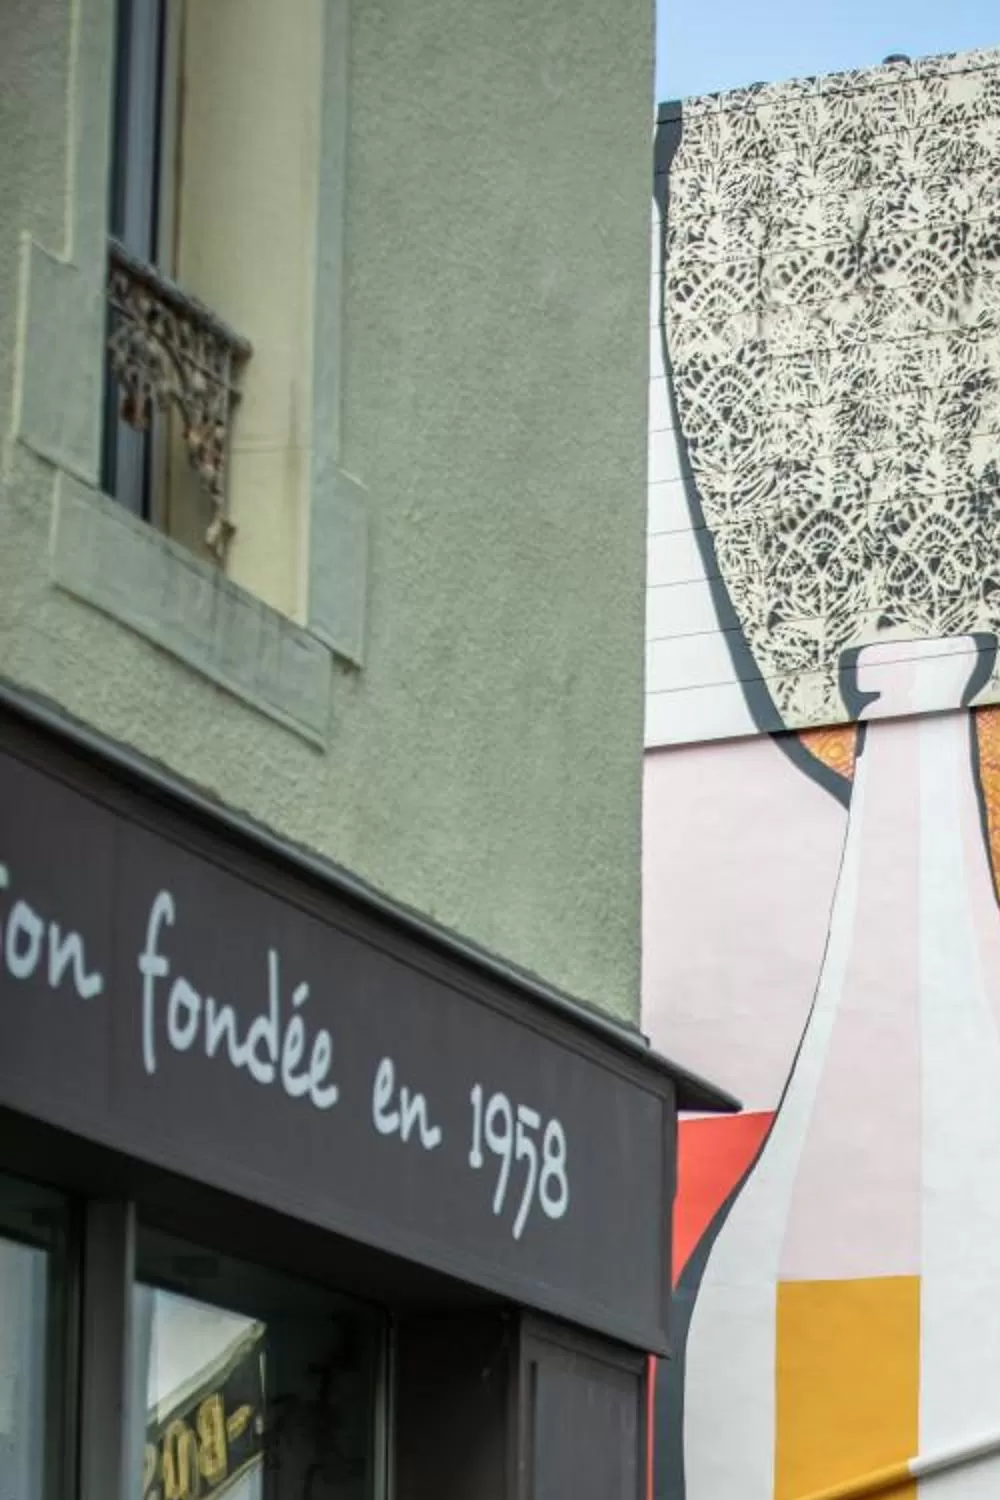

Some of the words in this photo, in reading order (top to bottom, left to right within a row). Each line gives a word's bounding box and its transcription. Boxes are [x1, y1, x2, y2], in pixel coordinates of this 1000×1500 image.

[0, 865, 104, 1000] on
[137, 890, 338, 1109] fondée
[372, 1057, 442, 1150] en
[468, 1082, 570, 1241] 1958
